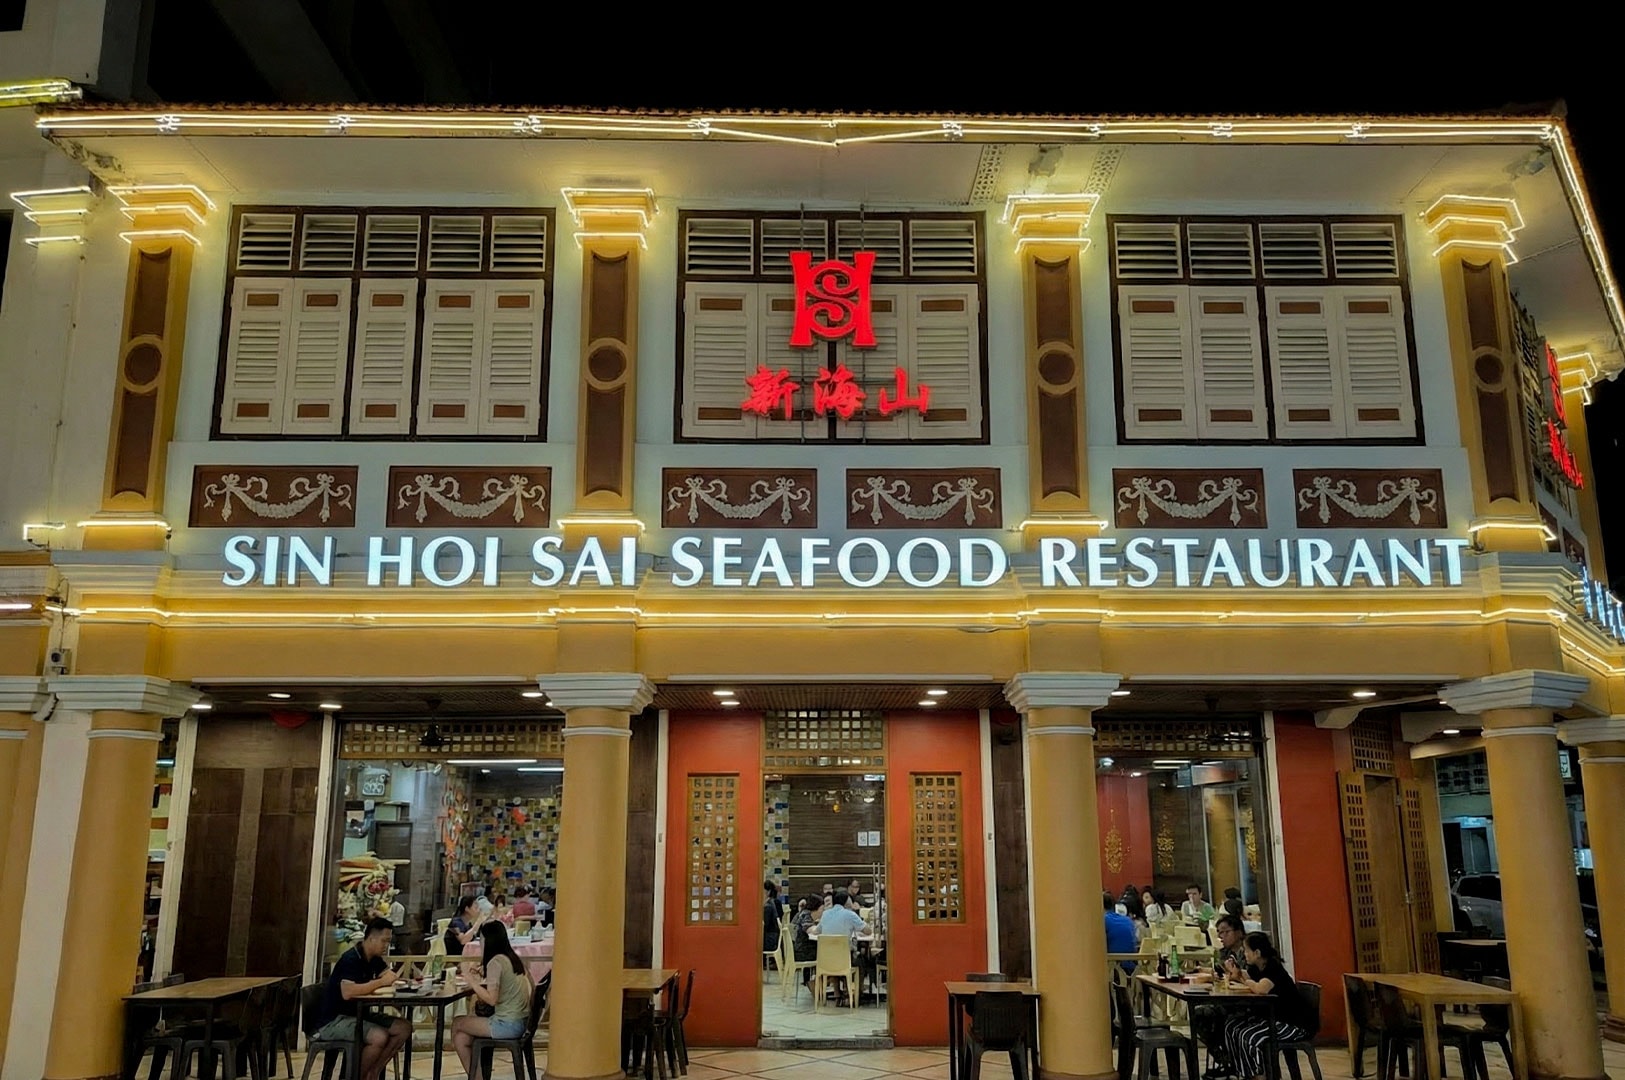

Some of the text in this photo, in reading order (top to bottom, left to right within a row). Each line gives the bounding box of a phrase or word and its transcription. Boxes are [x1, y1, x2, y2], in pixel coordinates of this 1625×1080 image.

[741, 364, 931, 419] 新海山
[222, 535, 1470, 588] SIN HOI SAI SEAFOOD RESTAURANT
